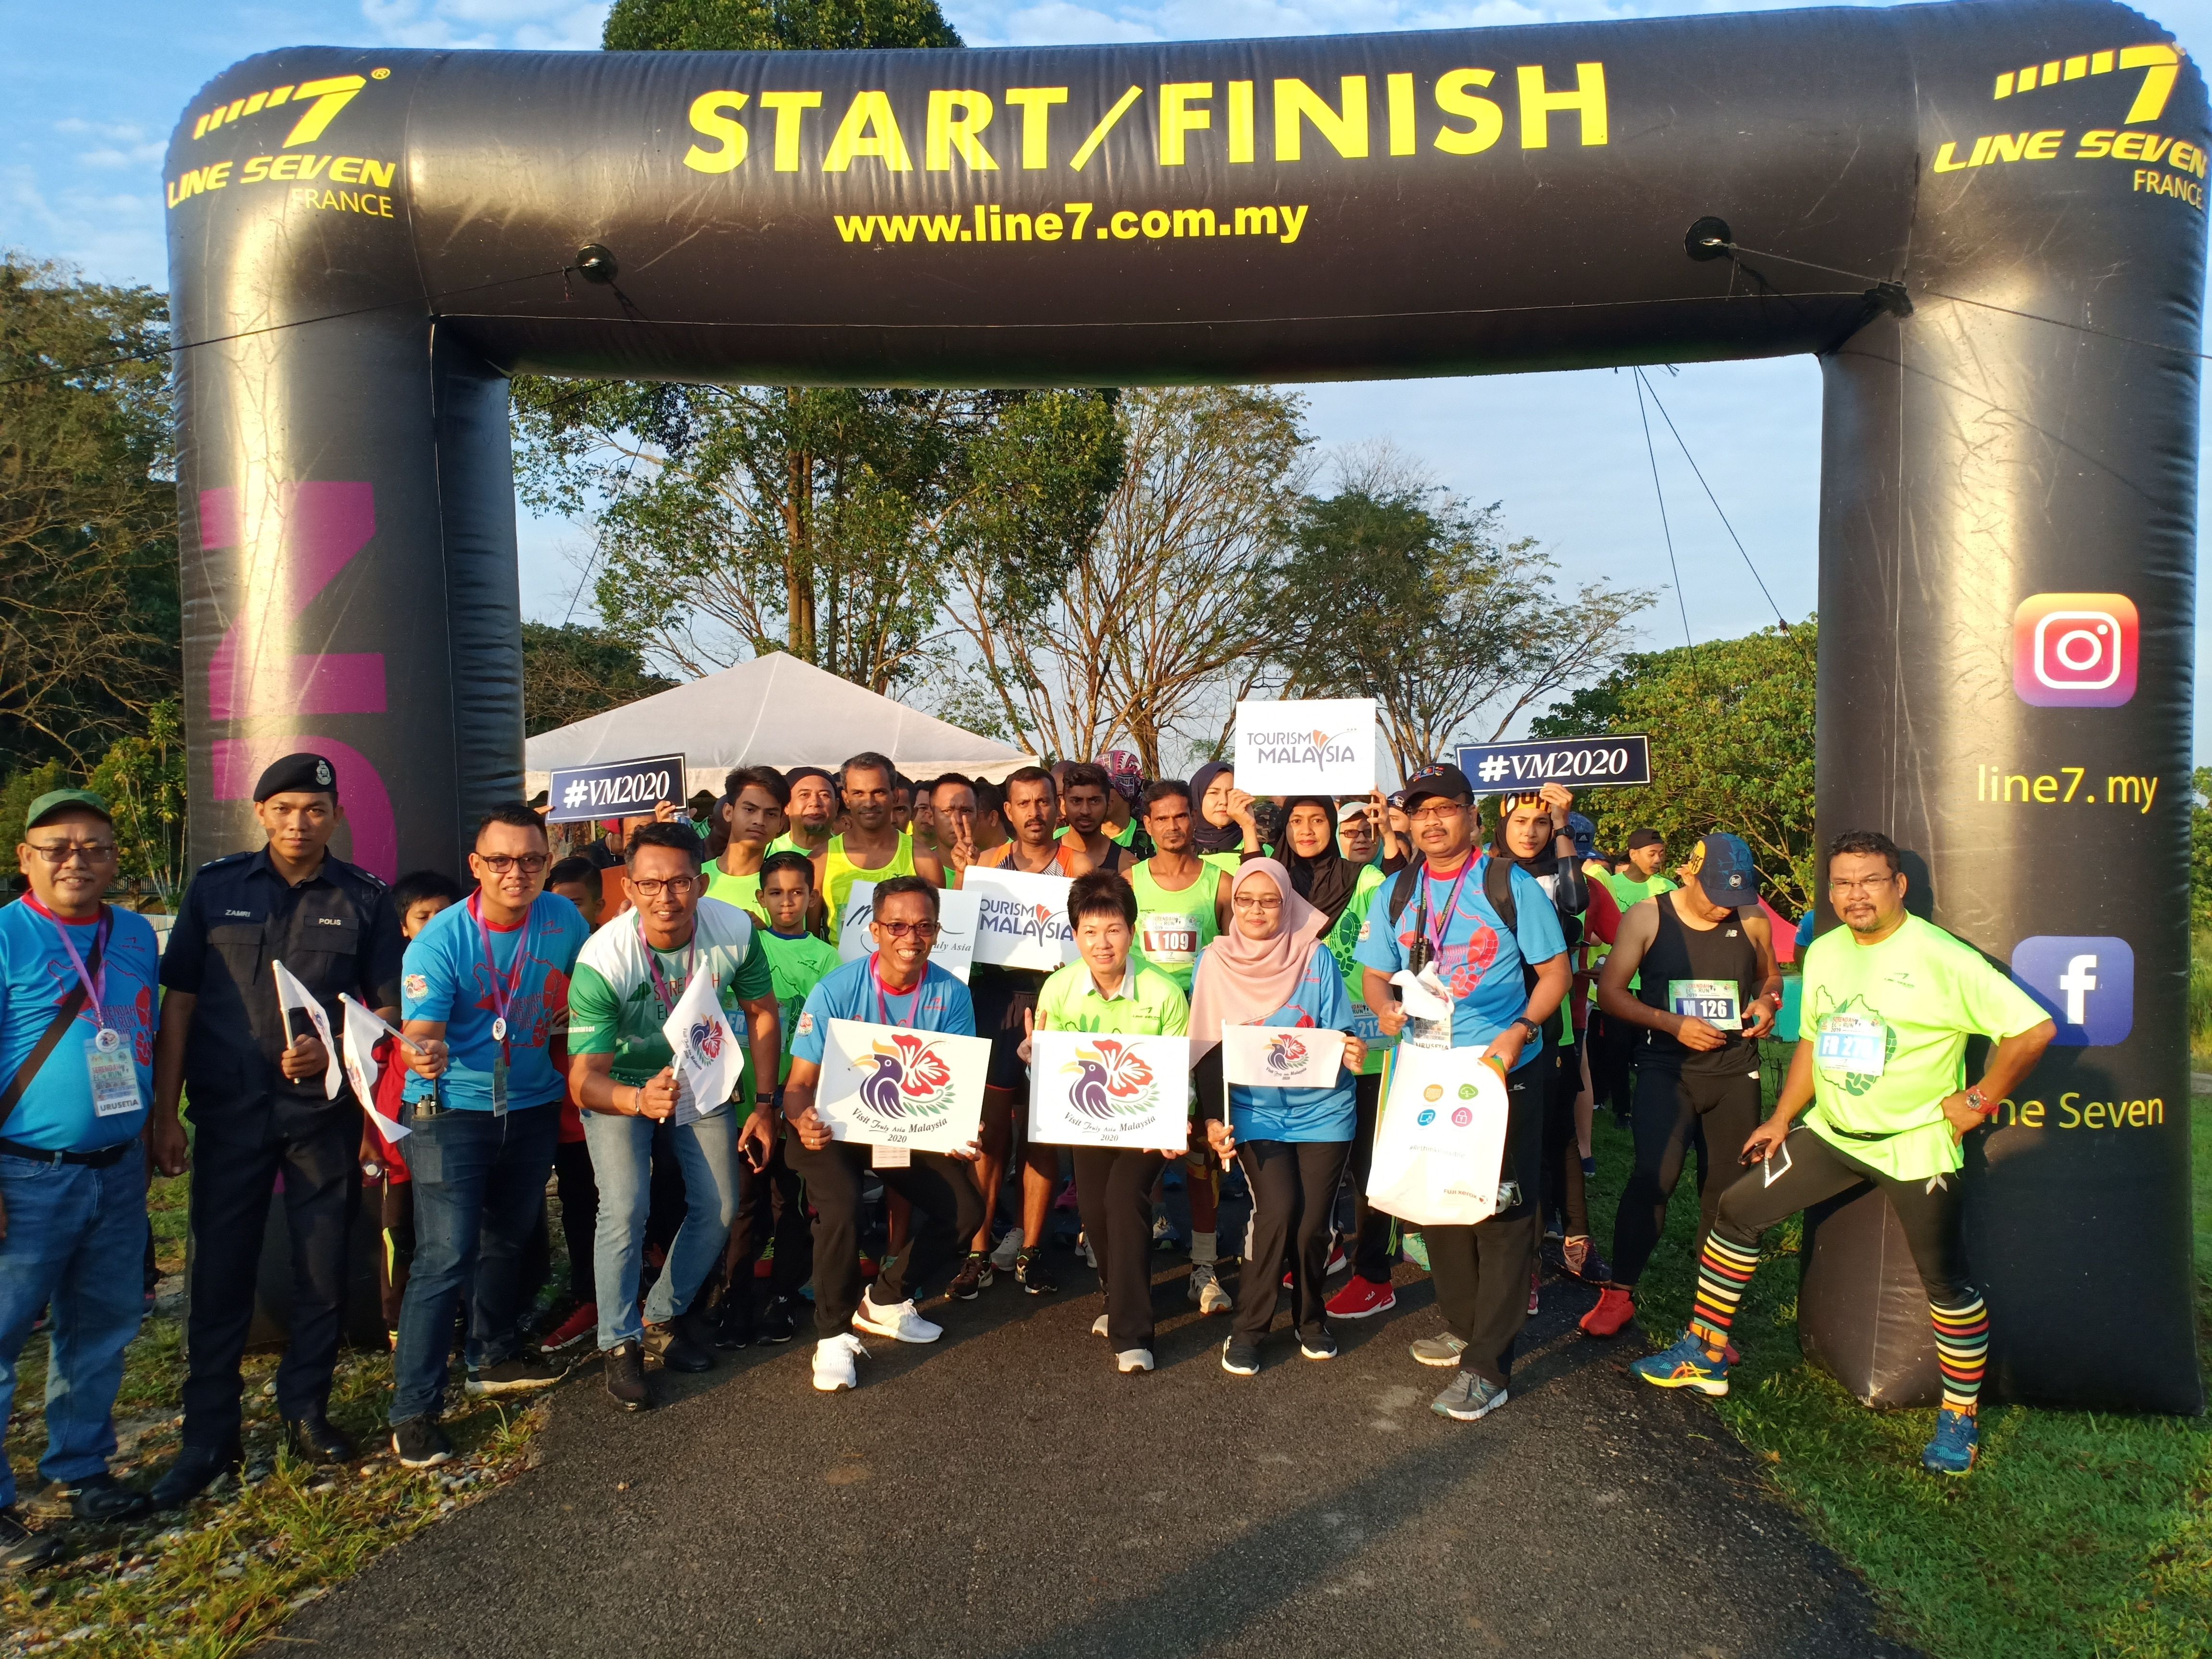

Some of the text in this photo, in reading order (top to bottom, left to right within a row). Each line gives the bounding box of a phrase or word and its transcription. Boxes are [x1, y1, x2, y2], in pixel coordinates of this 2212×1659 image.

[683, 62, 1608, 173] START/FINISH
[1934, 129, 2206, 180] LINE SEVEN
[168, 154, 397, 209] LINE SEVEN
[2133, 169, 2204, 210] FRANCE
[291, 188, 394, 218] FRANCE
[834, 203, 1309, 243] www.line7.com.my
[1247, 732, 1311, 745] TOURISM
[1258, 745, 1355, 772] MALAYSIA
[1479, 748, 1628, 782] #VM2020
[563, 770, 670, 809] #VM2020
[1978, 763, 2159, 814] line7. my
[225, 909, 251, 917] ZAMRI
[980, 899, 1035, 918] OURISM
[979, 913, 1074, 948] MALAYSIA
[1163, 933, 1189, 950] 109
[934, 941, 972, 952] uly Asia
[1683, 1000, 1727, 1018] M 126
[728, 1013, 746, 1032] FR
[1822, 1035, 1840, 1055] FR
[100, 1099, 139, 1112] URUSETIA
[2058, 1092, 2164, 1129] Seven
[852, 1107, 870, 1124] Visit
[870, 1119, 889, 1131] Truly
[908, 1118, 948, 1133] Malaysia
[1064, 1111, 1082, 1126] Visit
[1083, 1121, 1100, 1132] Truly
[1119, 1116, 1156, 1132] Malaysia
[887, 1134, 907, 1143] 2020
[1100, 1134, 1119, 1142] 2020
